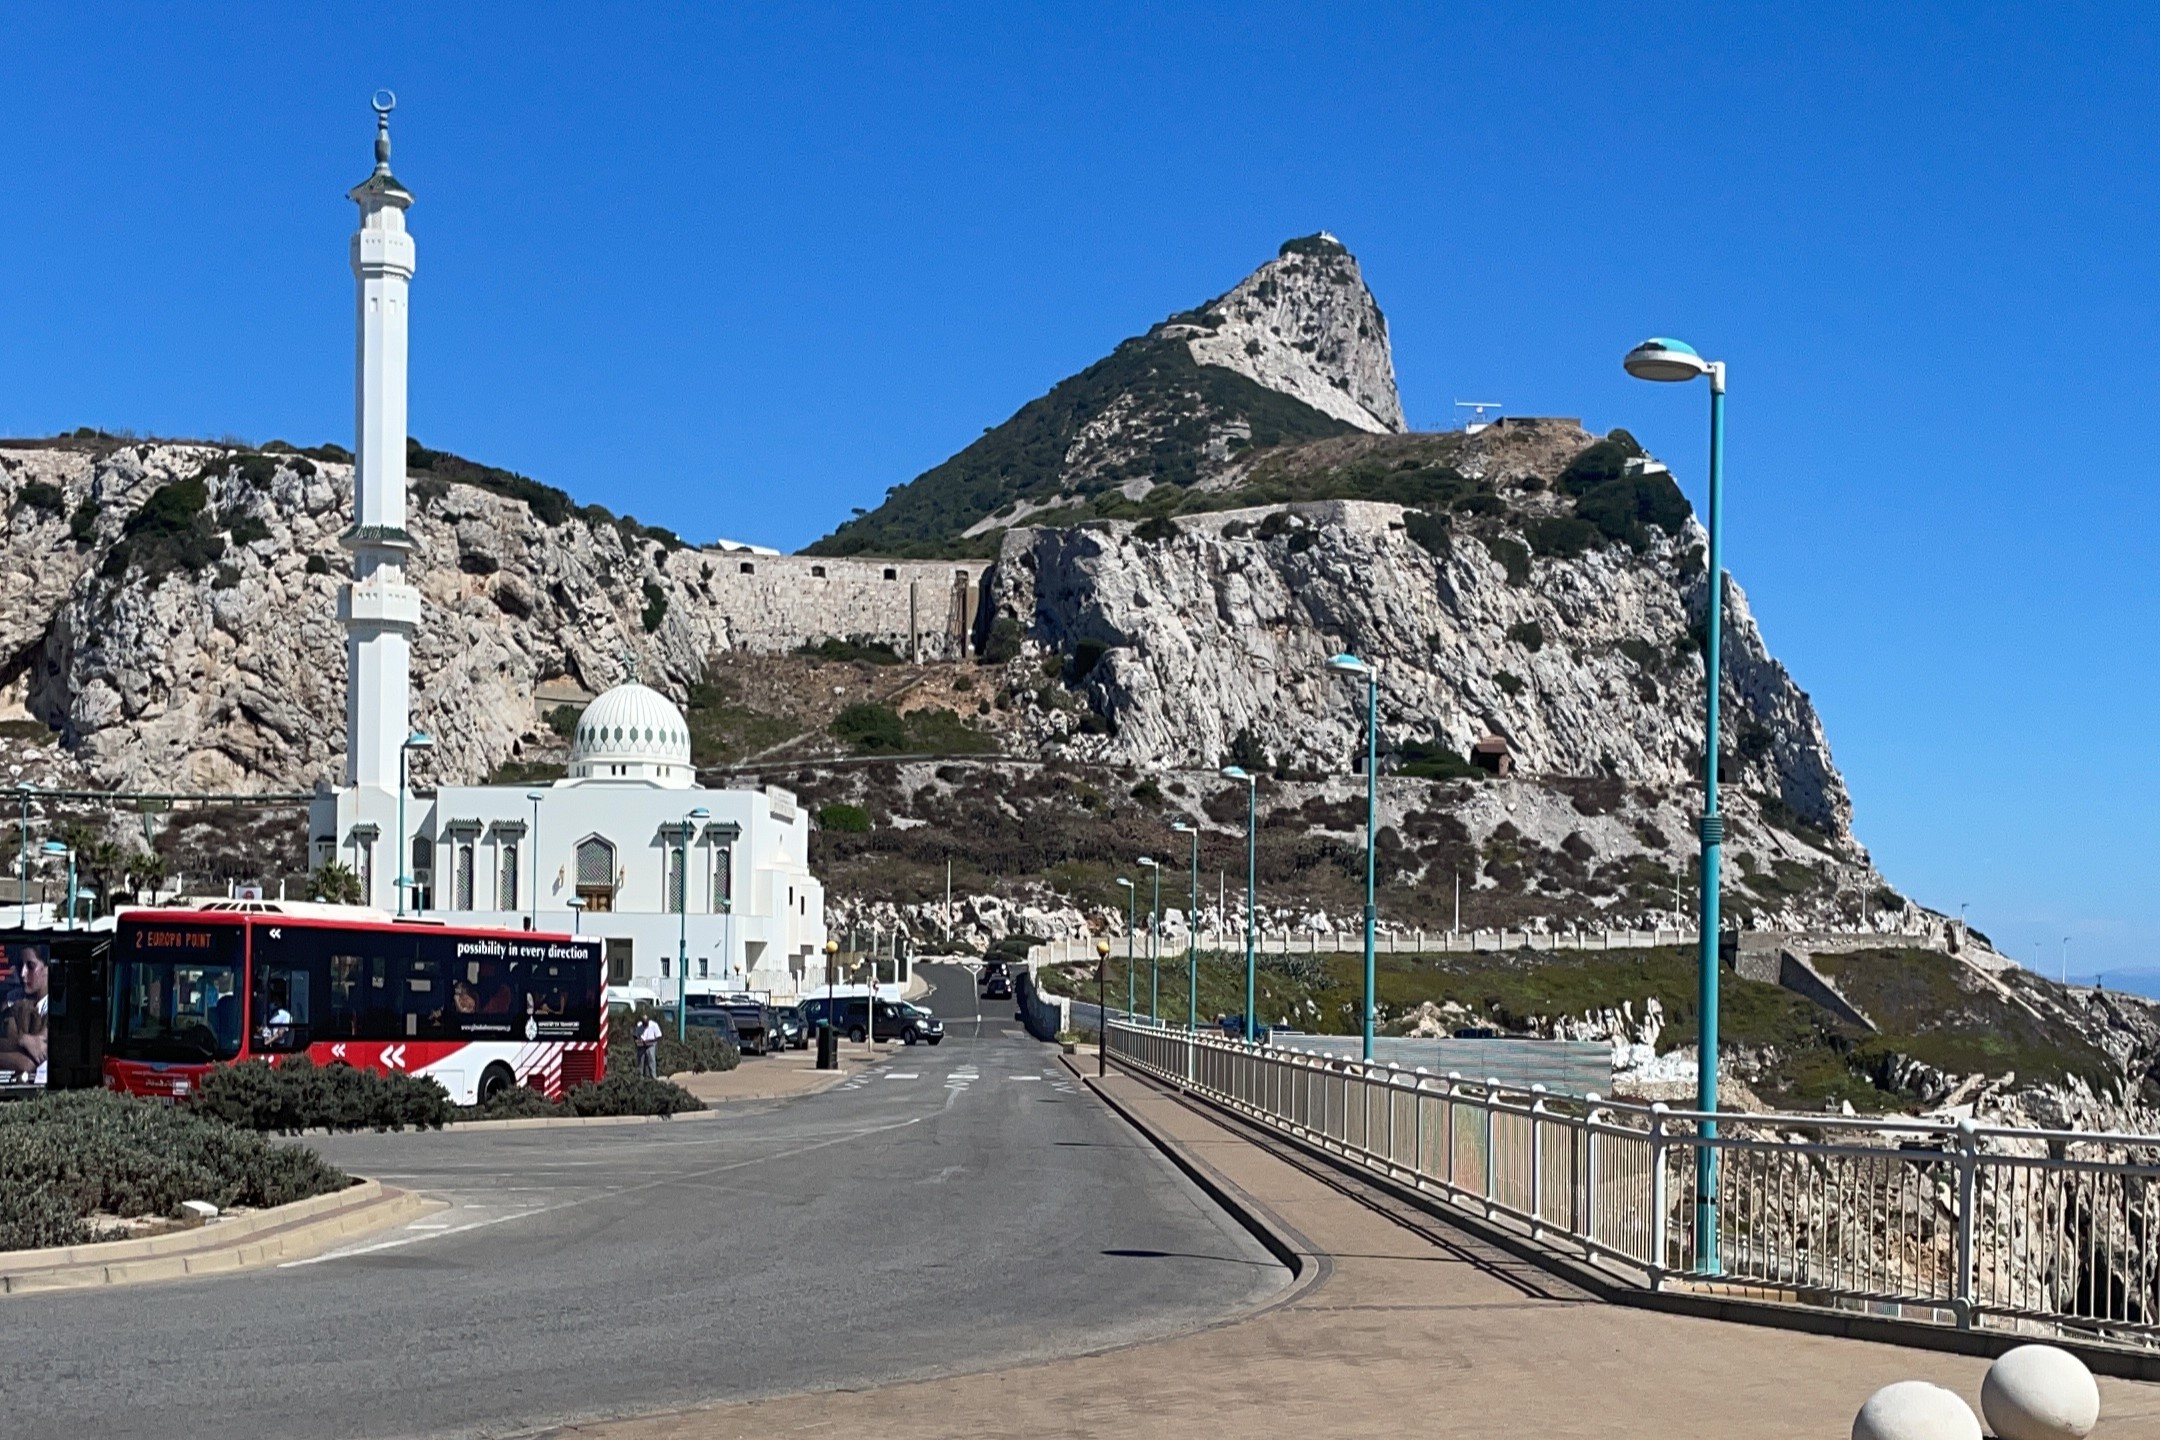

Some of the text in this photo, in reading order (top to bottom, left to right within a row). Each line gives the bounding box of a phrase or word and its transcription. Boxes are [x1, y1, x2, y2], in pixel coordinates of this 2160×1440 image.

[136, 931, 211, 948] 2 EUROPA POINT
[457, 940, 588, 961] possibility in every direction
